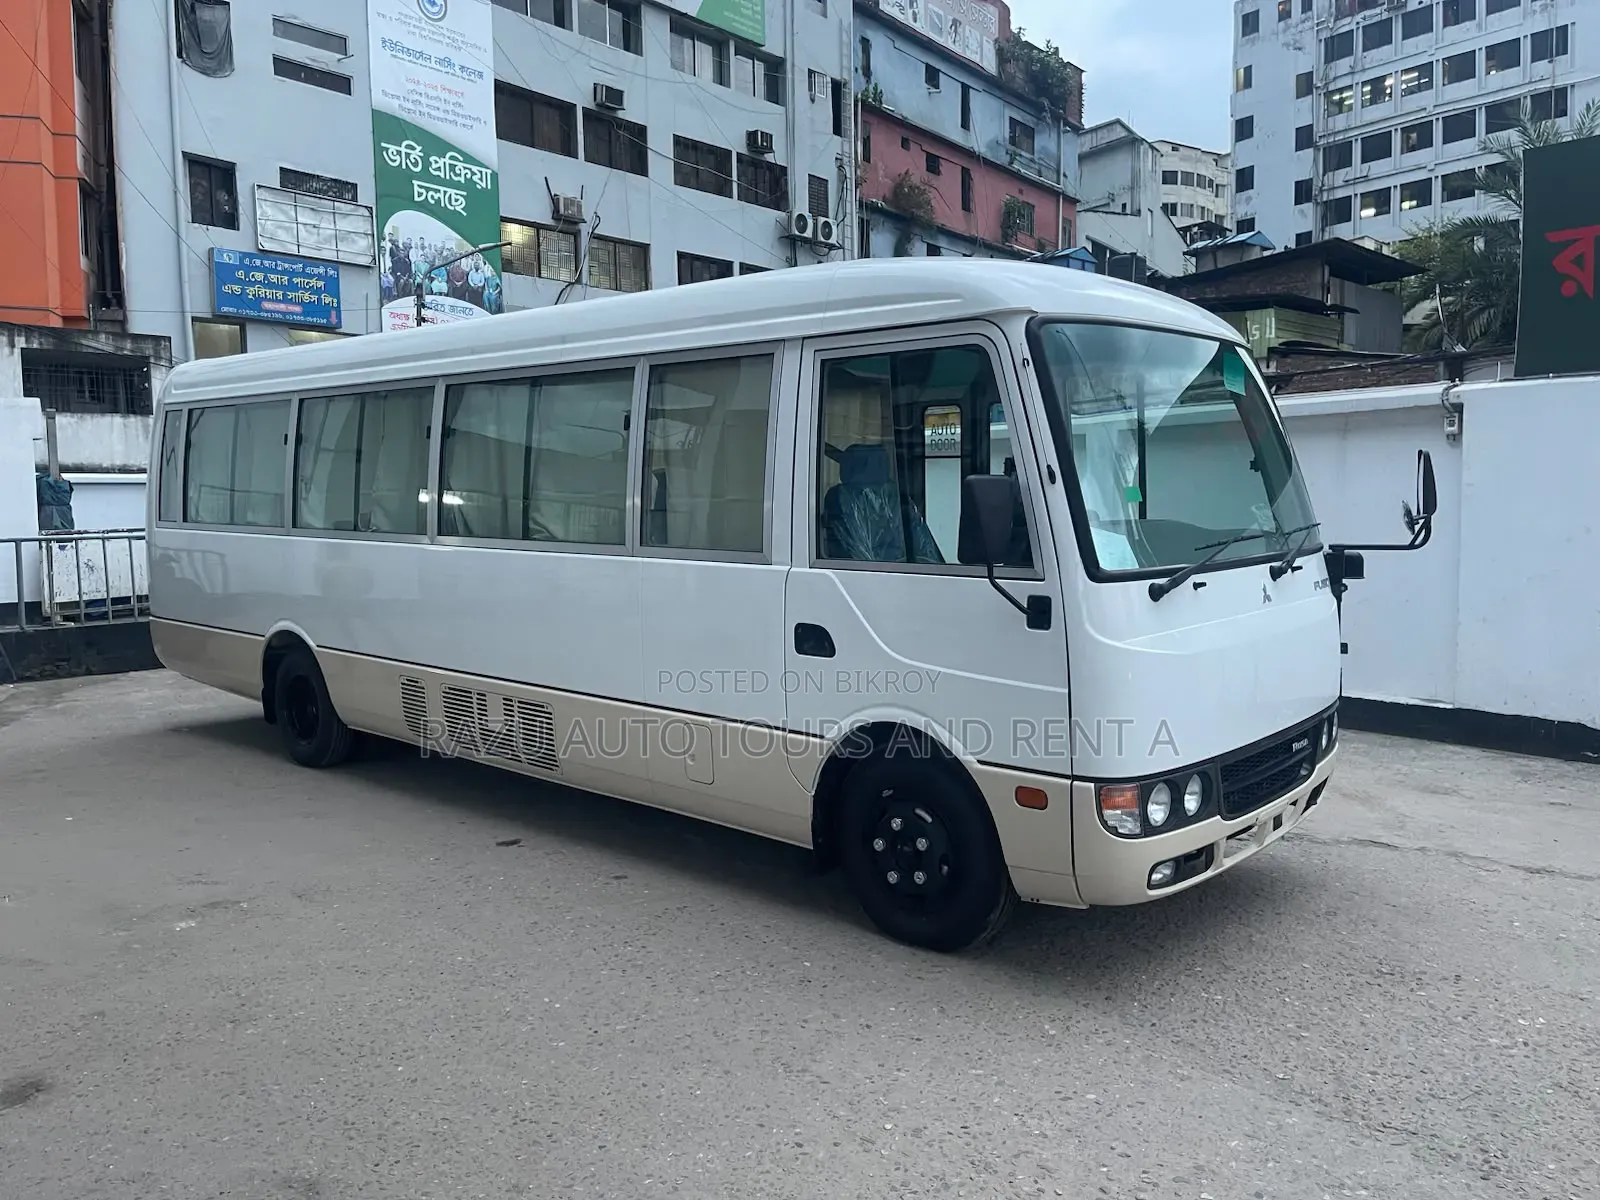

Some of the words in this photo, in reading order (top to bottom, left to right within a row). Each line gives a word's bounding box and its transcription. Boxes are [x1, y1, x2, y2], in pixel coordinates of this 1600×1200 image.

[380, 37, 432, 64] ইউনিভার্সেল
[434, 56, 457, 73] নার্সিং
[458, 64, 484, 80] কলেজ
[381, 140, 424, 172] ভর্তি
[428, 151, 493, 190] প্রক্রিয়া
[412, 180, 467, 217] চলছে
[235, 269, 289, 286] এ.জে.আর
[292, 276, 325, 291] পার্সেল
[245, 284, 284, 300] কুরিয়ার
[286, 290, 319, 305] সার্ভিস
[321, 293, 338, 307] লিঃ
[447, 304, 474, 316] জানতে
[931, 423, 956, 436] AUTO
[930, 438, 956, 451] DOOR
[1292, 738, 1309, 752] Rosa
